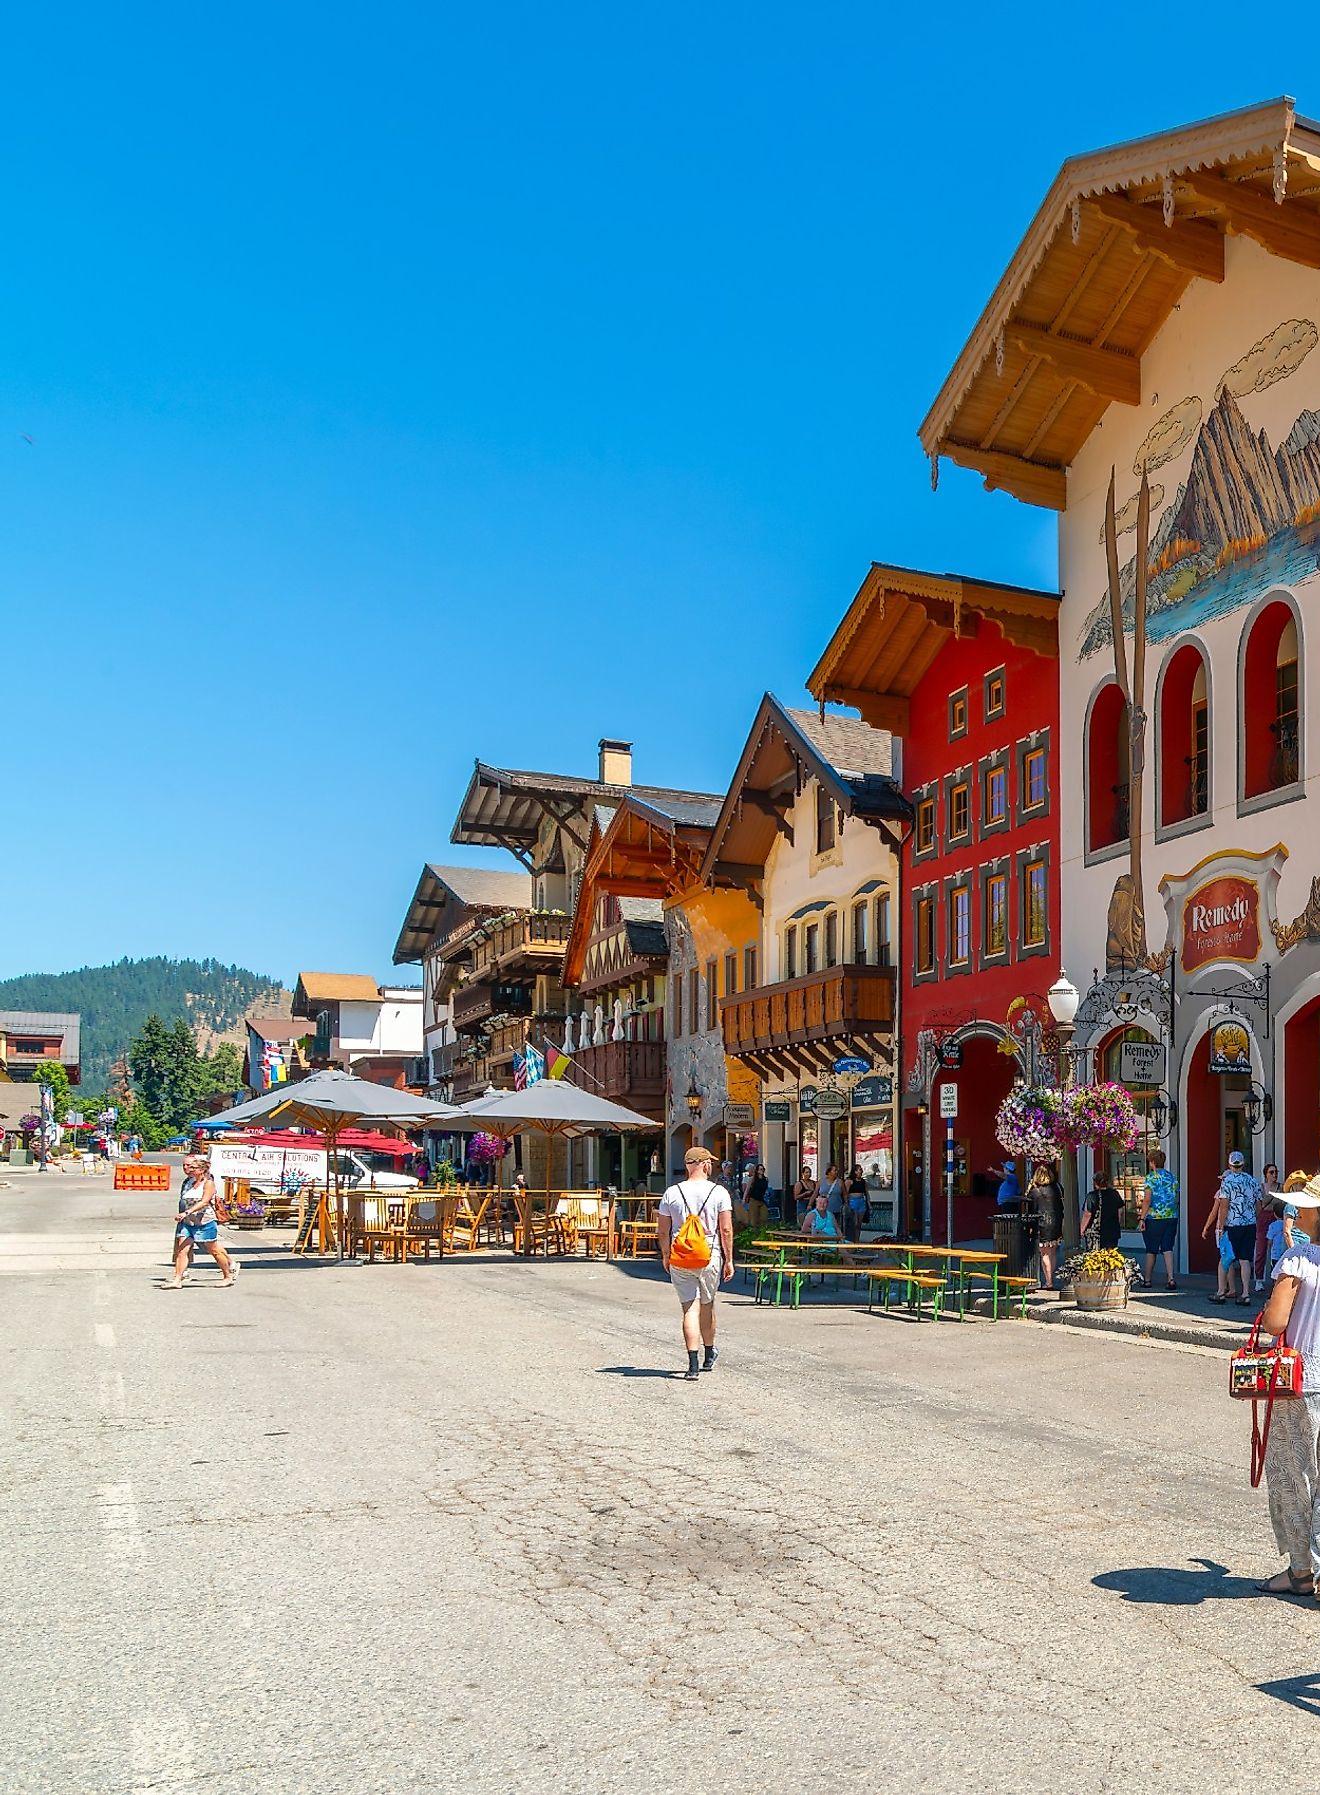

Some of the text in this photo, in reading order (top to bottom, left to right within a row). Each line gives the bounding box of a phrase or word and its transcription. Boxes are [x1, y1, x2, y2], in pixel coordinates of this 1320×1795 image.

[1192, 896, 1249, 933] Remedy
[1124, 1044, 1161, 1060] Remedy
[1132, 1058, 1154, 1067] Forest
[1134, 1072, 1152, 1080] Home
[944, 1085, 954, 1095] 30
[221, 1151, 258, 1161] CENTRA
